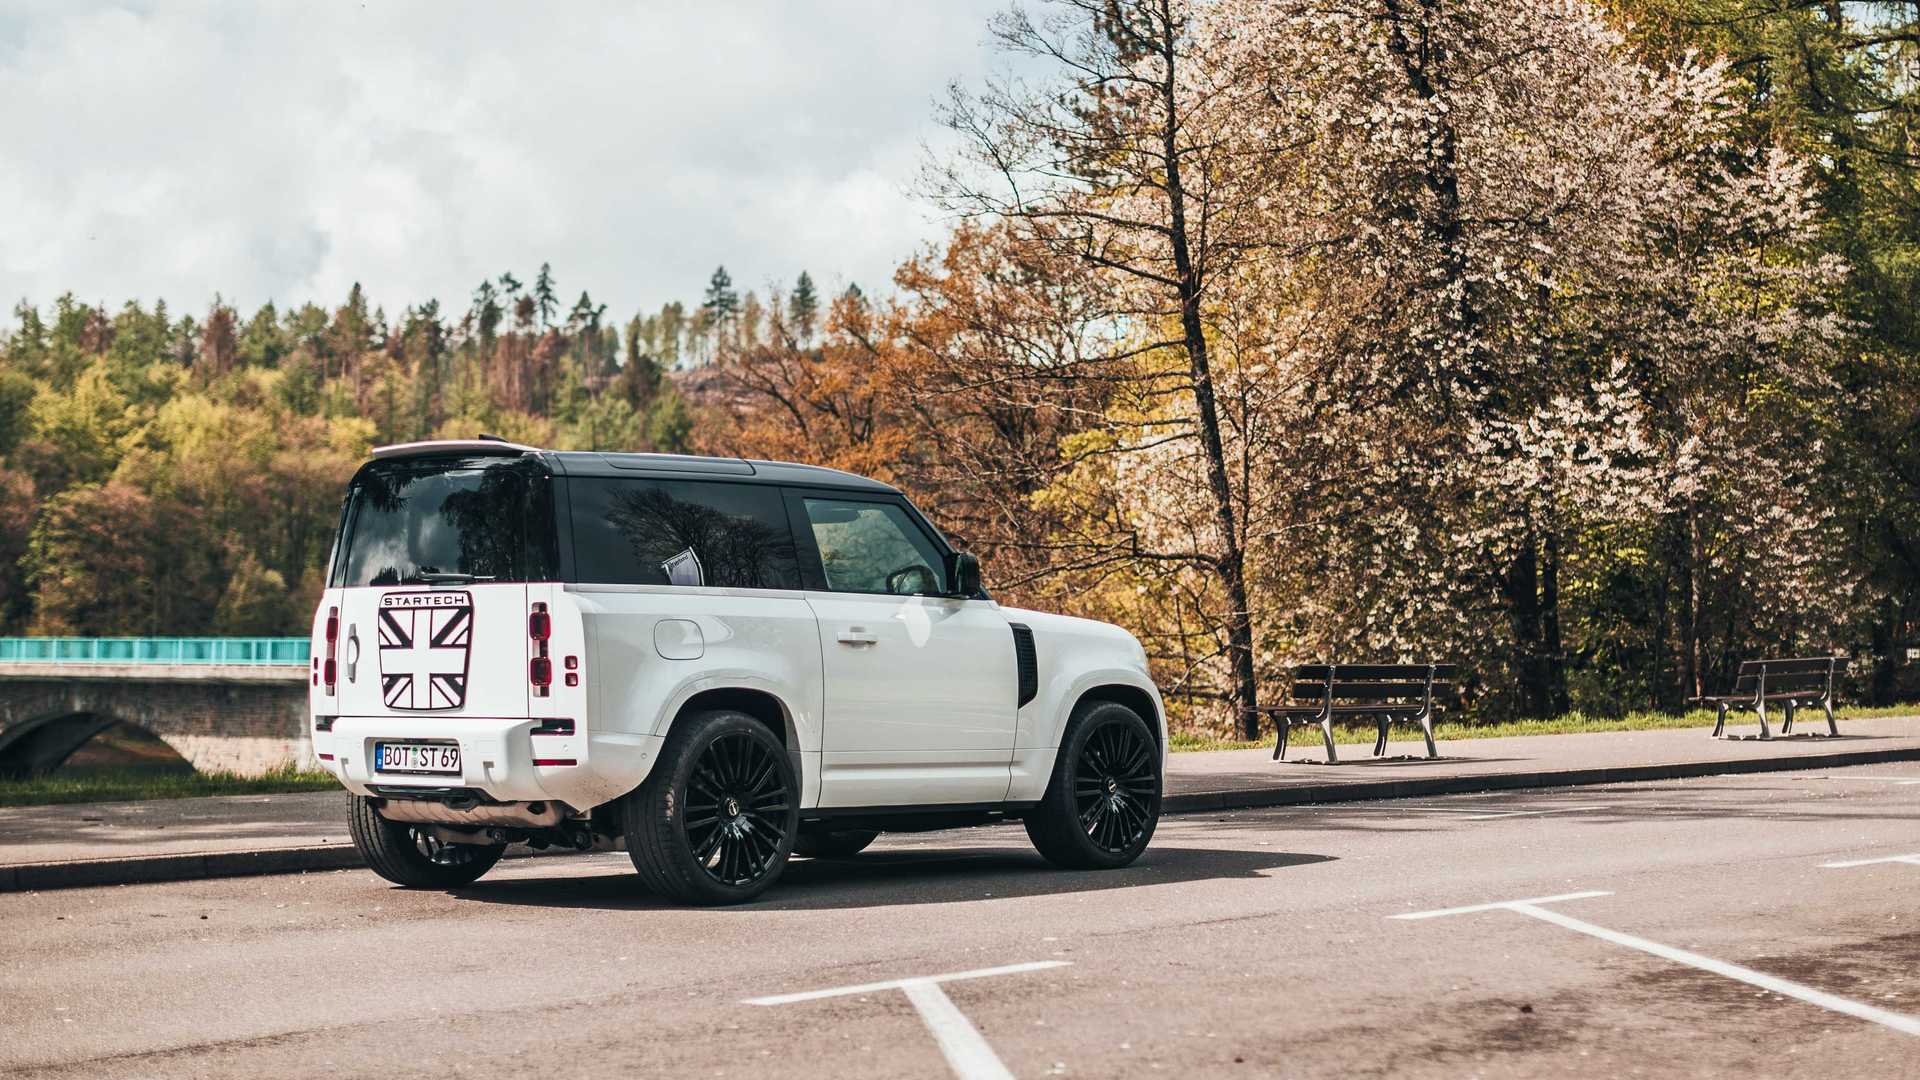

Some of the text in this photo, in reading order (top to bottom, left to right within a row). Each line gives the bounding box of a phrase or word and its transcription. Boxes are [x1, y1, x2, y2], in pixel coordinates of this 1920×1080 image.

[384, 596, 464, 606] STARTECH
[384, 746, 459, 768] BOT ST 69
